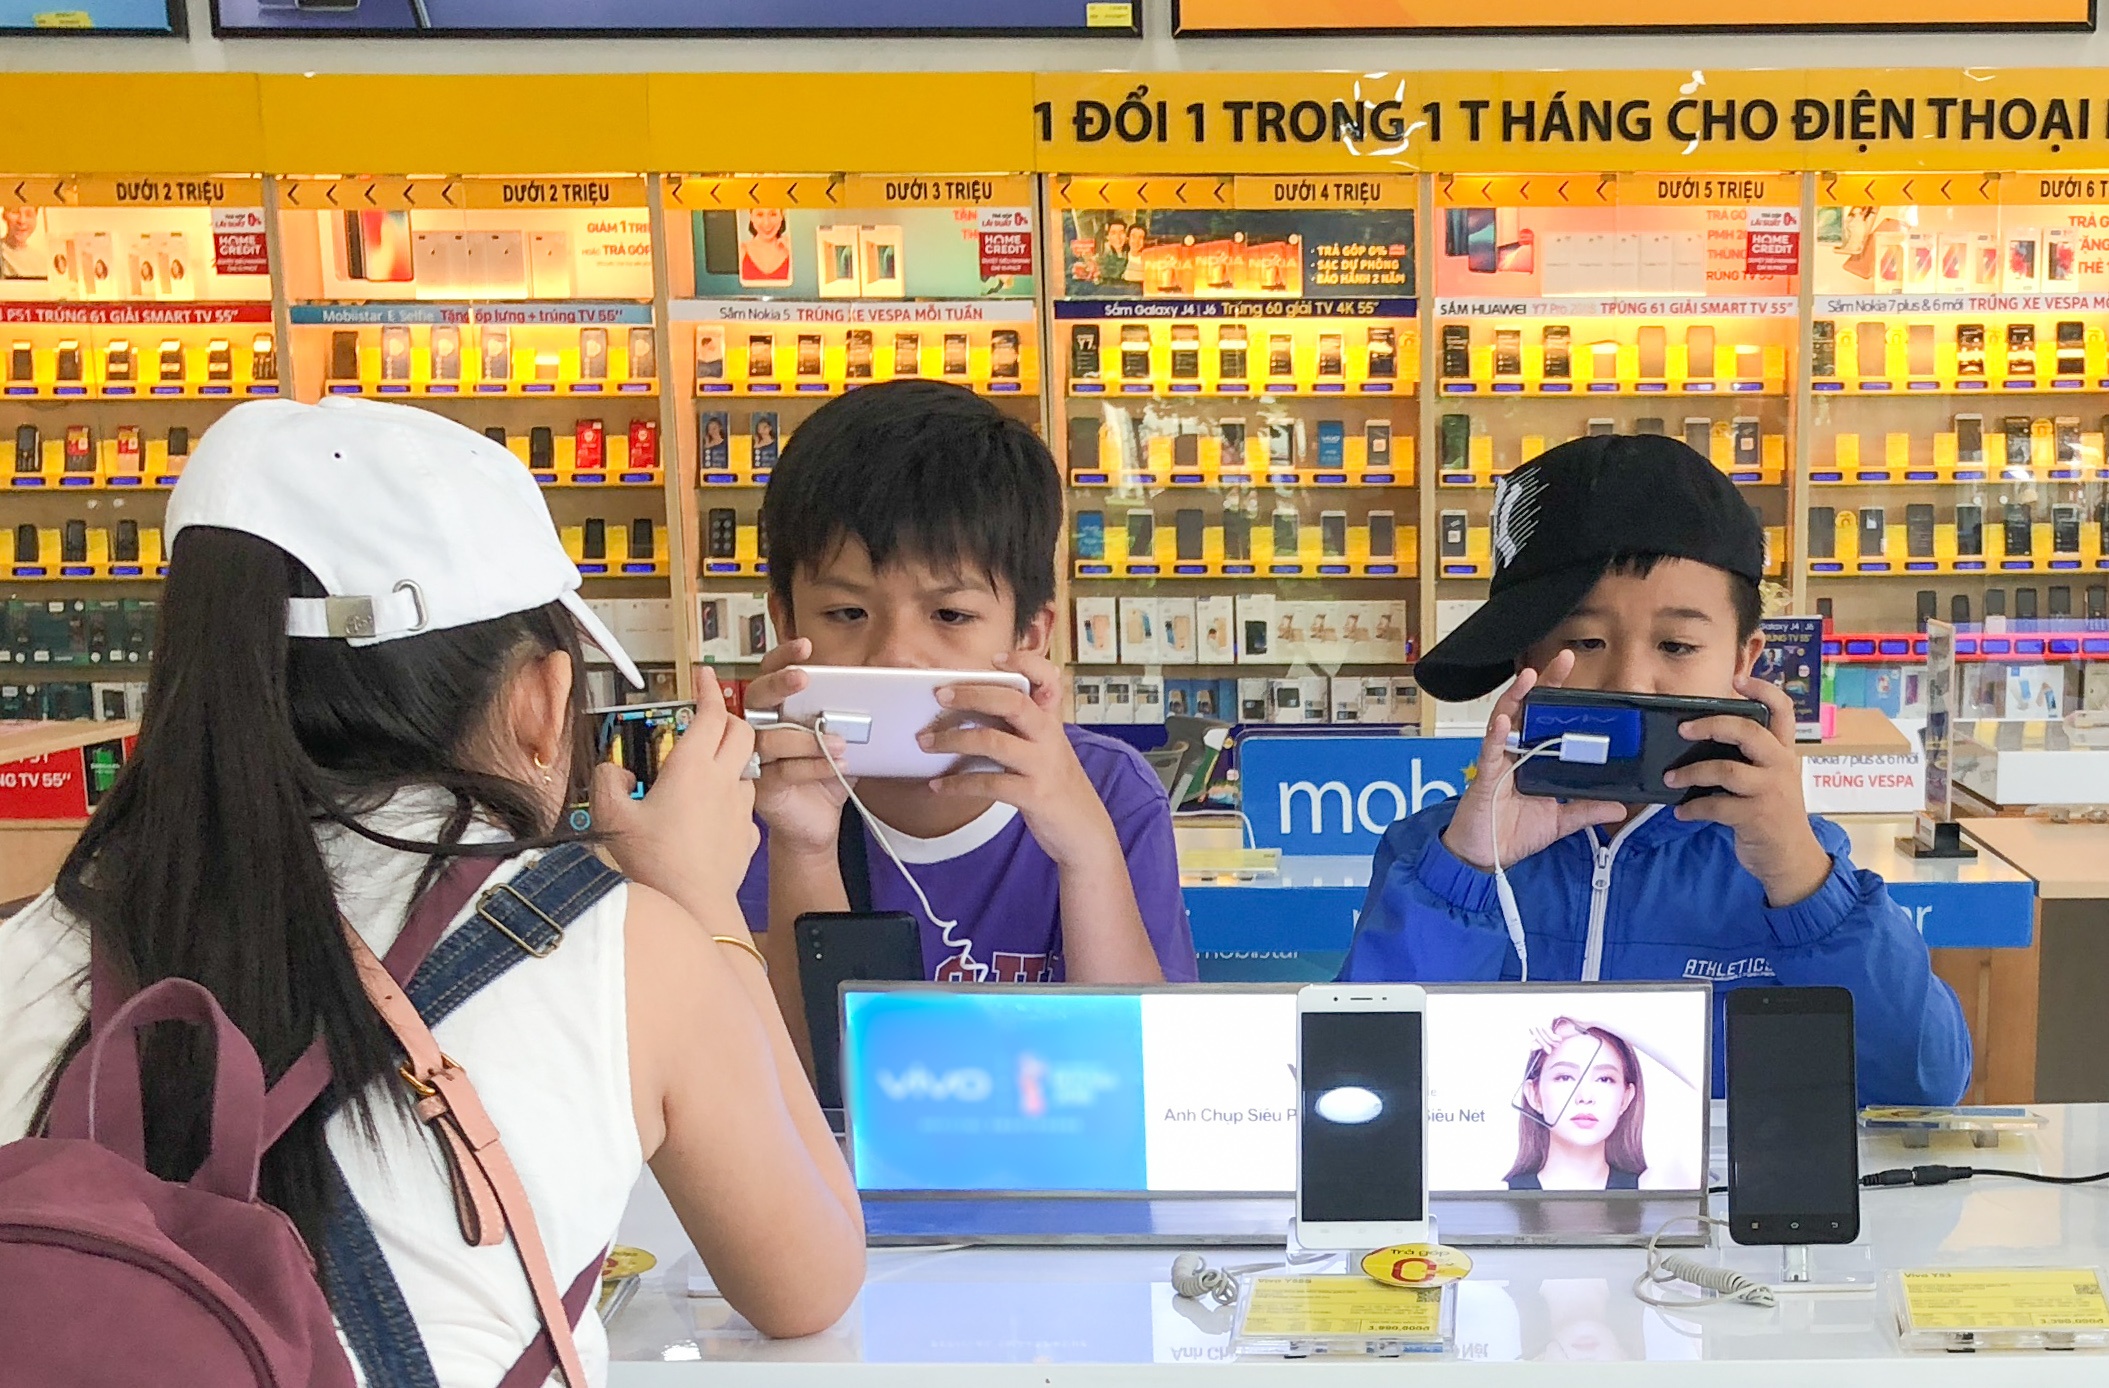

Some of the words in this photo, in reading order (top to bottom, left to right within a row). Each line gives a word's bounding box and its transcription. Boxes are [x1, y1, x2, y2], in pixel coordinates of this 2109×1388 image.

[1033, 102, 1053, 141] 1
[1073, 85, 1167, 142] ĐỔI
[1186, 102, 1205, 141] 1
[1223, 100, 1405, 142] TRONG
[1423, 101, 1441, 141] 1
[1667, 98, 1777, 142] CHO
[1791, 89, 1920, 152] ĐIỆN
[1928, 97, 2089, 152] THOẠI
[116, 179, 158, 201] DƯỚI
[163, 182, 172, 201] 2
[177, 180, 224, 205] TRIỆU
[503, 181, 544, 202] DƯỚI
[550, 184, 558, 202] 2
[562, 182, 609, 205] TRIỆU
[886, 179, 927, 200] DƯỚI
[933, 182, 941, 200] 3
[949, 180, 992, 204] TRIỆU
[1274, 180, 1316, 201] DƯỚI
[1321, 183, 1329, 201] 4
[1334, 181, 1381, 205] TRIỆU
[1658, 178, 1700, 199] DƯỚI
[1704, 181, 1712, 199] 5
[1717, 179, 1764, 203] TRIỆU
[2040, 176, 2081, 198] DƯỚI
[2087, 180, 2095, 198] 6
[620, 219, 627, 233] 1
[985, 234, 1022, 244] HOME
[1752, 234, 1789, 244] HOME
[985, 244, 1026, 255] CREDIT
[1751, 244, 1793, 254] CREDIT
[1372, 274, 1379, 284] 2
[748, 308, 781, 320] Nokia
[796, 305, 844, 321] TRÚNG
[868, 308, 911, 321] VESPA
[1134, 304, 1179, 318] Galaxy
[1181, 304, 1195, 315] J4
[1202, 304, 1217, 315] J6
[1265, 302, 1282, 315] 60
[1315, 302, 1333, 315] TV
[1336, 302, 1355, 315] 4K
[1472, 304, 1527, 315] HUAWEI
[1650, 302, 1665, 314] 61
[1701, 302, 1747, 314] SMART
[1750, 302, 1768, 313] TV
[1856, 299, 1887, 312] Nokia
[1888, 299, 1896, 312] 7
[1897, 299, 1920, 314] plus
[1921, 299, 1931, 311] &
[1932, 299, 1940, 311] 6
[2022, 297, 2040, 310] XE
[2045, 296, 2089, 310] VESPA
[142, 309, 191, 323] SMART
[194, 309, 212, 322] TV
[578, 310, 595, 322] TV
[18, 772, 40, 788] TV
[1868, 775, 1914, 787] VESPA
